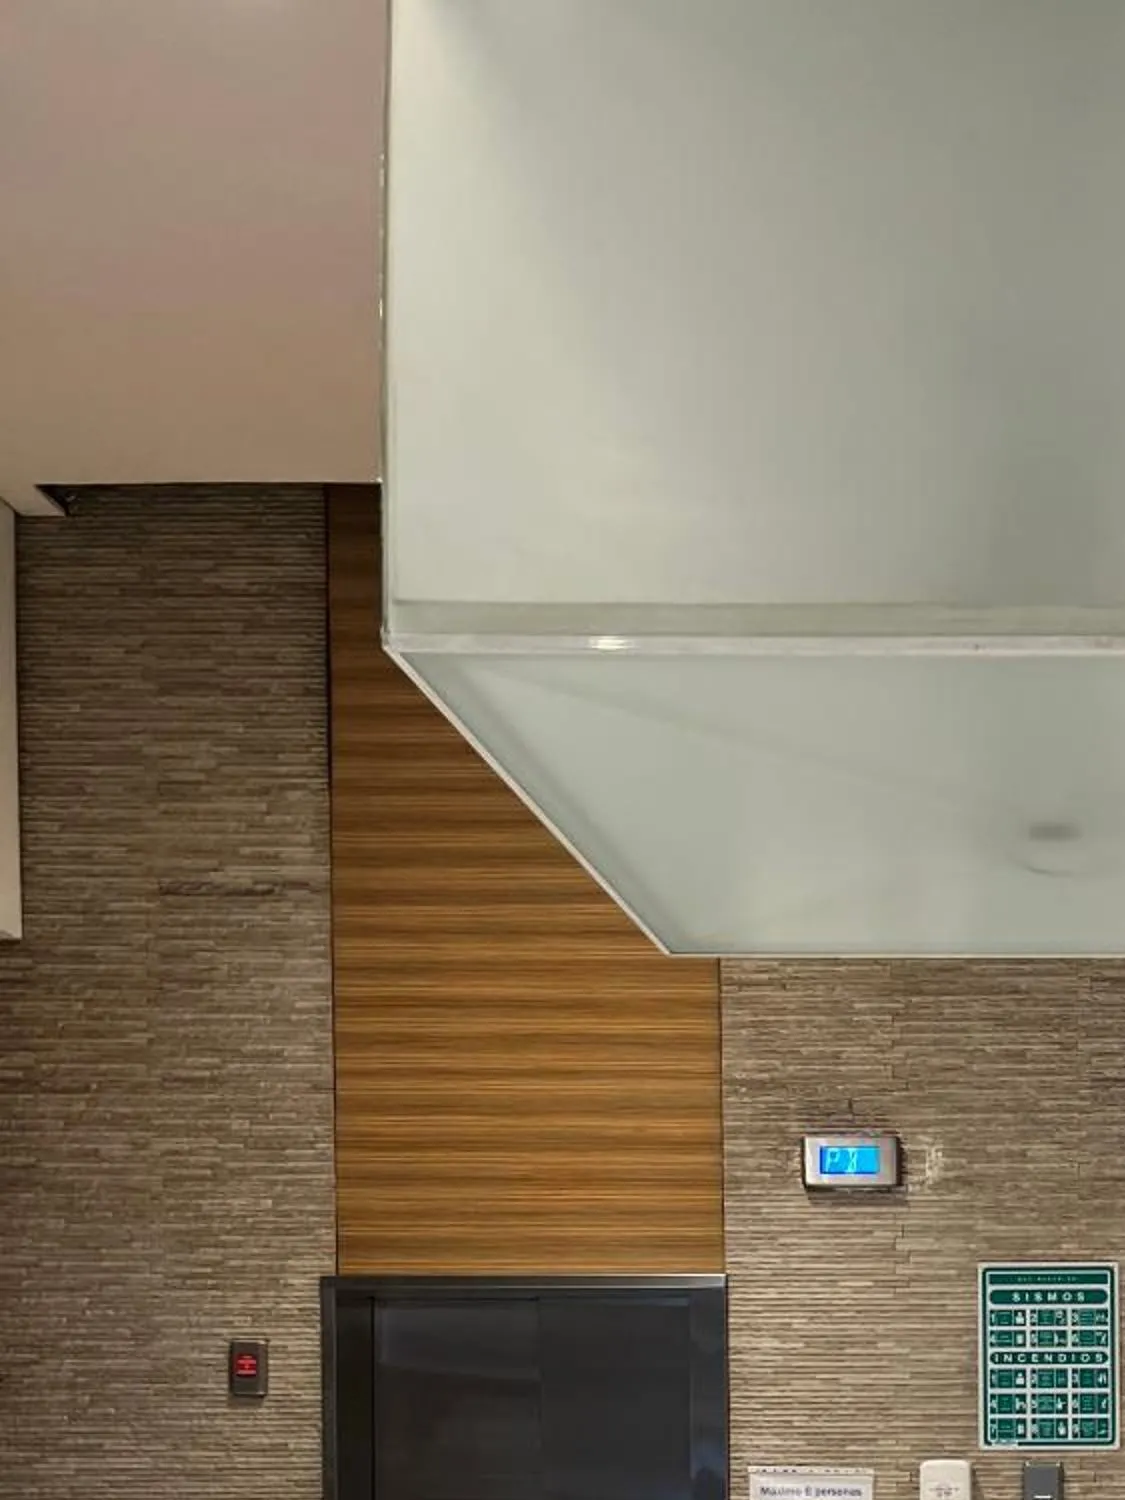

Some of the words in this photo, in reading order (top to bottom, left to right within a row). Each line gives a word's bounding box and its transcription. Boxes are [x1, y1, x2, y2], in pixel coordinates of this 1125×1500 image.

[1011, 1291, 1085, 1303] SISMOS
[995, 1353, 1103, 1363] INCENDIOS
[815, 1487, 862, 1498] personas
